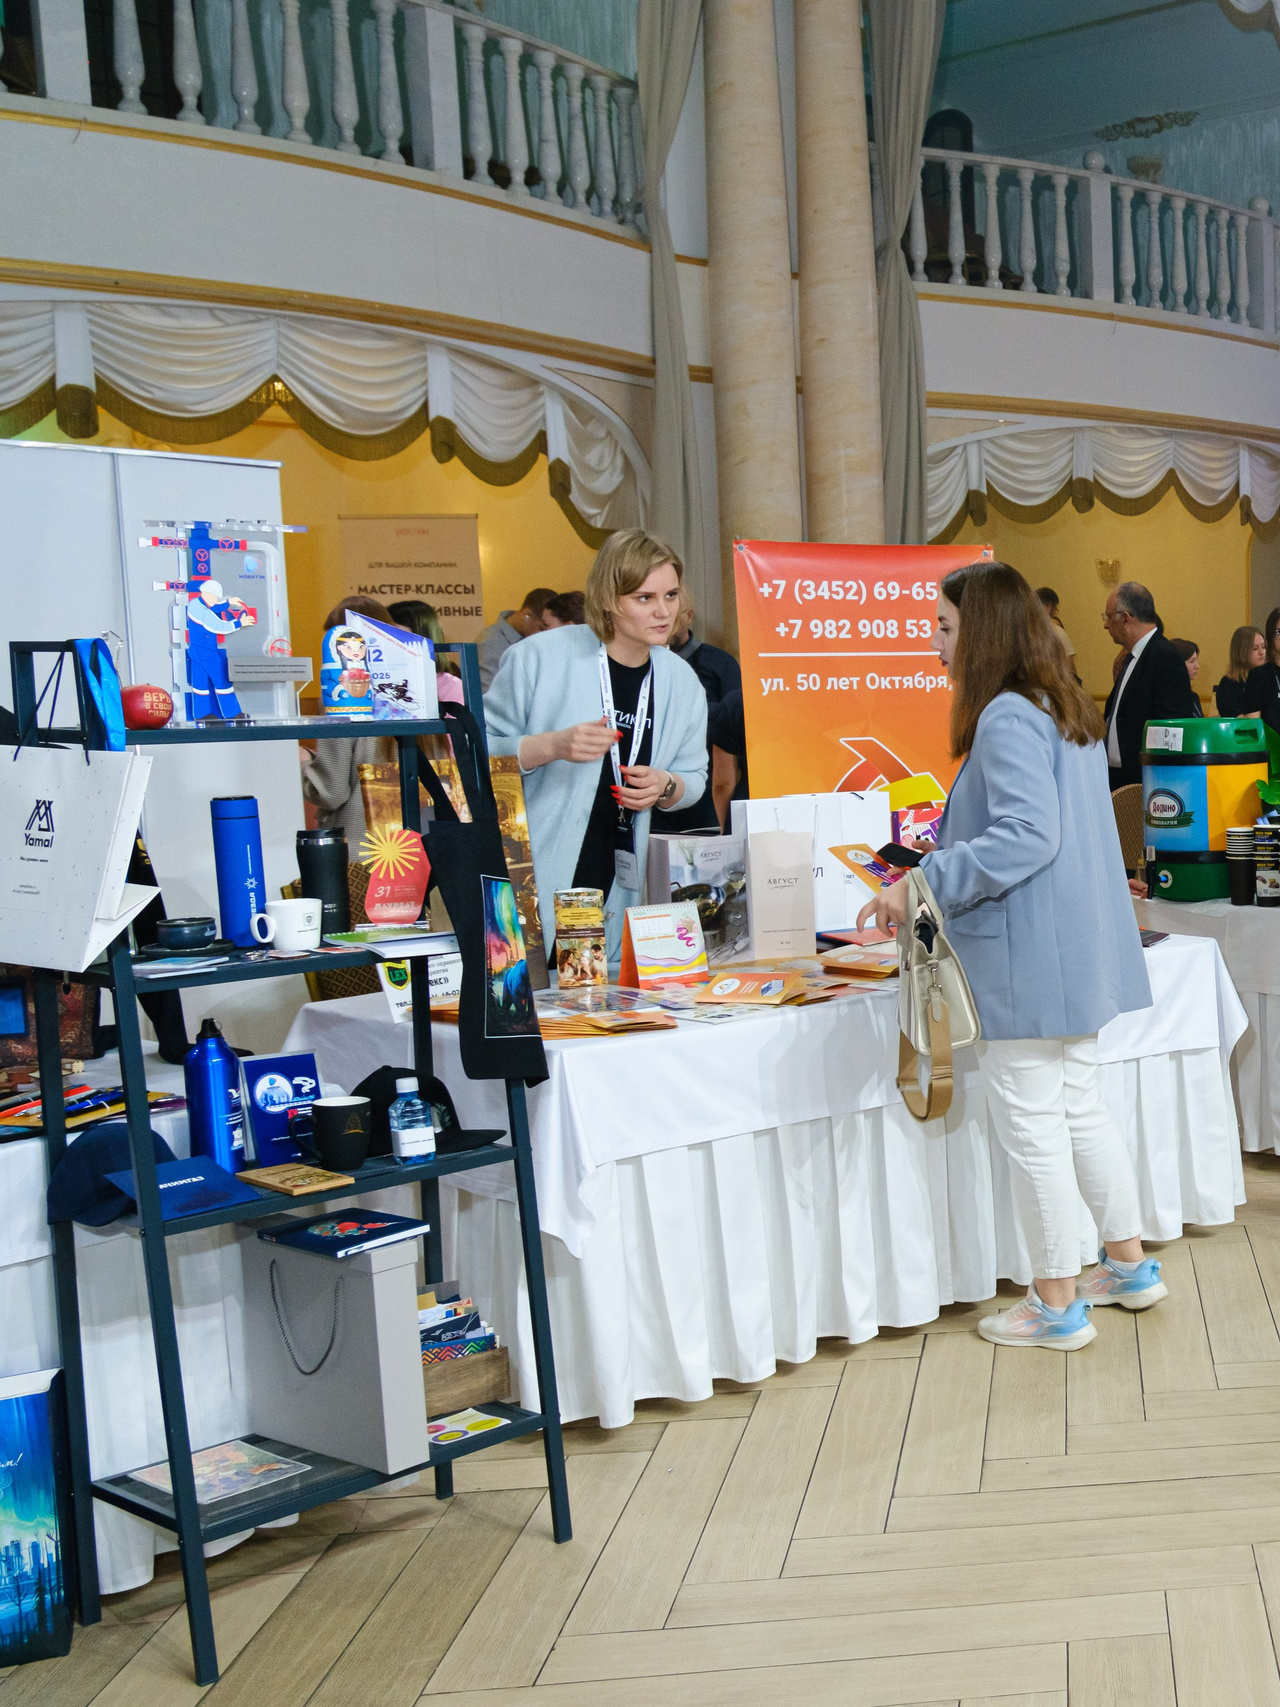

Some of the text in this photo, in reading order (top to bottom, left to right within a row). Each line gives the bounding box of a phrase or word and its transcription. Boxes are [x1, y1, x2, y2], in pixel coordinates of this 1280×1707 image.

[357, 584, 475, 595] МАСТЕР-КЛАССЫ
[759, 579, 787, 599] +7
[794, 578, 867, 605] (3452)
[434, 606, 482, 617] ИВНЫЕ
[776, 619, 932, 639] +7 982 908 53
[760, 671, 953, 696] ул. 50 лет Октября,
[143, 692, 171, 703] ВЕРЬ
[148, 710, 170, 718] СИЛЫ
[1153, 801, 1176, 813] Додино
[24, 833, 54, 848] Yamal
[374, 886, 391, 898] 31
[389, 969, 408, 982] LEX
